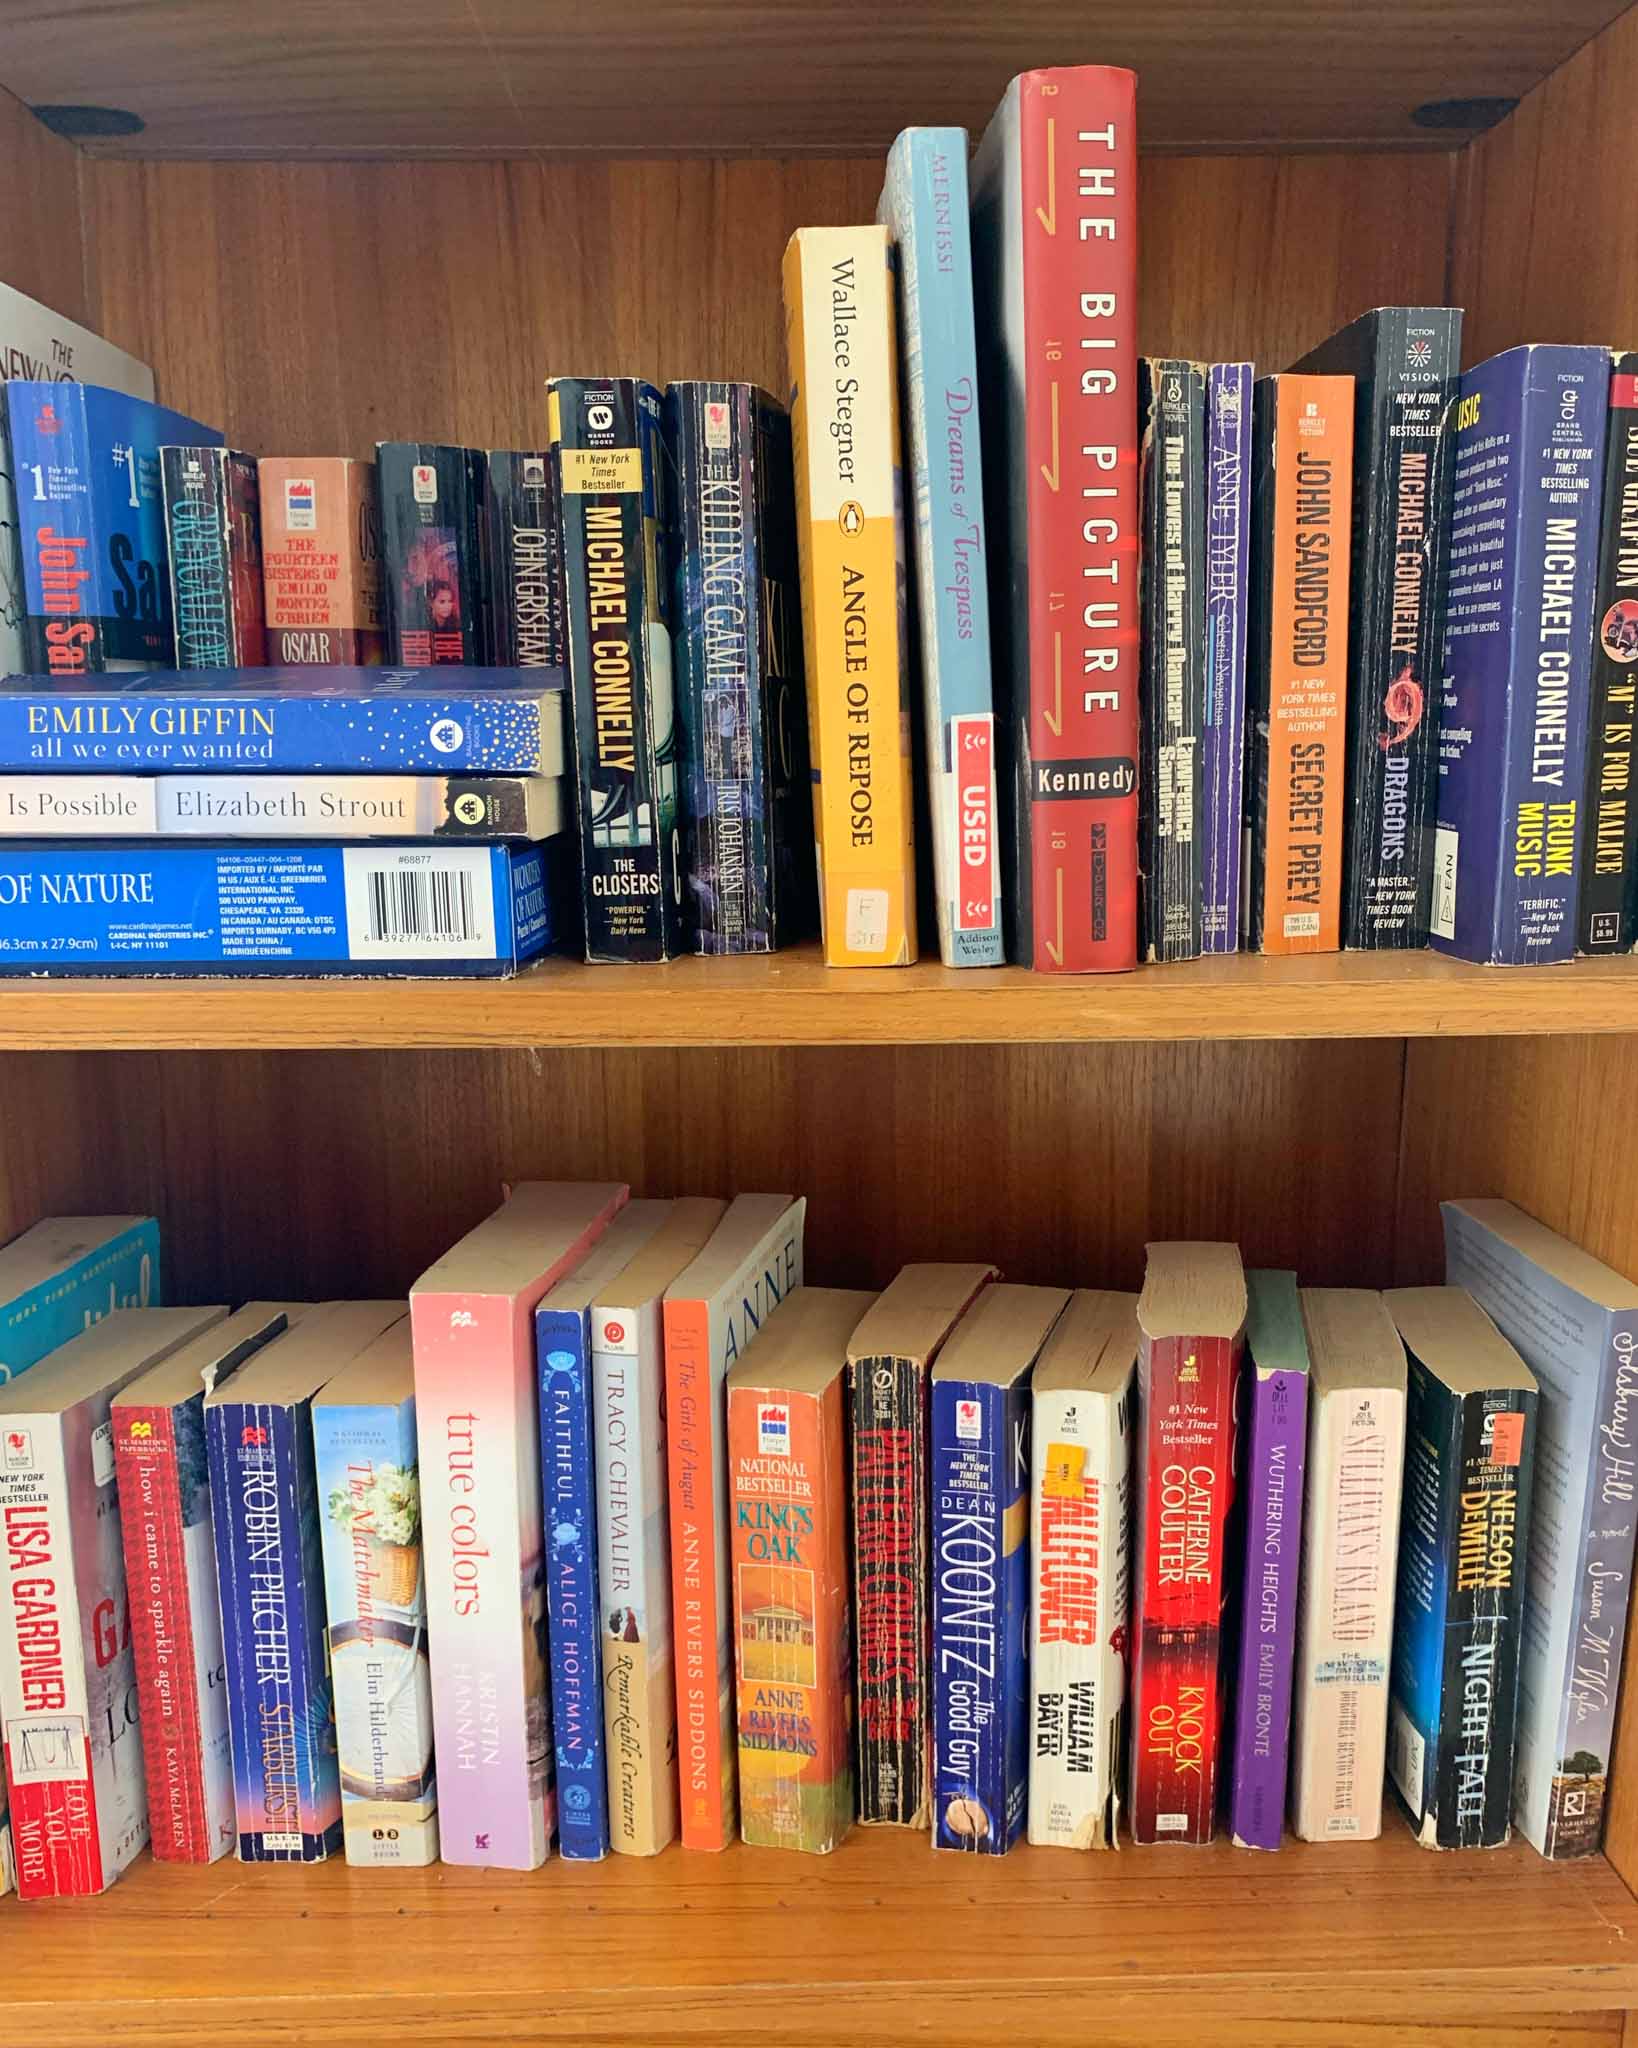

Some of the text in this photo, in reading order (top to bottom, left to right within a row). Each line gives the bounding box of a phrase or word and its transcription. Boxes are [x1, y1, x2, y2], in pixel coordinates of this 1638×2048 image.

[1407, 328, 1435, 337] FICTION
[51, 338, 74, 368] THE
[829, 256, 859, 485] Wallace Stegner
[1399, 372, 1440, 382] VISION
[1557, 374, 1584, 383] FICTION
[584, 393, 614, 402] FICTION
[1395, 393, 1442, 405] NEW YORK
[1078, 121, 1121, 714] THE BIG PICTURE
[1404, 409, 1431, 421] TIMES
[1389, 425, 1442, 437] BESTSELLER
[1553, 448, 1571, 459] NEW
[1572, 448, 1593, 459] YORK
[591, 466, 617, 478] Times
[704, 464, 734, 480] THE
[1555, 463, 1577, 474] TIMES
[581, 479, 626, 490] Bestseller
[1212, 446, 1241, 521] ANNE
[1541, 477, 1590, 489] BESTSELLING
[1549, 492, 1579, 504] AUTHOR
[287, 538, 315, 552] THE
[701, 480, 747, 597] KILLING
[264, 552, 339, 566] FOURTEEN
[1292, 452, 1332, 668] JOHN SANDFORD
[1390, 452, 1427, 655] MICHAEL CONNELLY
[264, 567, 340, 581] SISTERS OF
[1210, 532, 1238, 604] TYLER
[277, 582, 328, 595] EMILIO
[1166, 436, 1186, 728] The Loves of Harry Dancer
[275, 597, 331, 610] MONTEZ
[512, 524, 552, 669] JOHN GRISHAM
[275, 611, 331, 625] O'BRIEN
[281, 631, 331, 664] OSCAR
[585, 506, 636, 773] MICHAEL CONNELLY
[703, 604, 747, 687] GAME
[1532, 517, 1577, 787] MICHAEL CONNELLY
[842, 565, 873, 848] ANGLE OF REPOSE
[1280, 691, 1337, 704] YORK TIMES
[27, 706, 276, 736] EMILY GIFFIN
[1277, 706, 1338, 720] BESTSELLING
[1287, 721, 1326, 733] AUTHOR
[31, 737, 274, 760] all we ever wanted
[1038, 764, 1135, 793] Kennedy
[1288, 742, 1325, 834] SECRET
[8, 789, 407, 819] Is Possible Elizabeth Strout
[1380, 757, 1410, 861] DRAGONS
[962, 785, 988, 867] USED
[1514, 799, 1577, 878] TRUNK MUSIC
[398, 855, 432, 866] #68877
[613, 858, 637, 874] THE
[592, 873, 659, 897] CLOSERS
[1286, 843, 1322, 905] PREY
[0, 871, 154, 905] OF NATURE
[1366, 904, 1413, 915] TIMES BOOK
[610, 926, 647, 936] Daily News
[1373, 918, 1405, 929] REVIEW
[1520, 924, 1560, 934] Times Book
[364, 934, 481, 944] 6 39277 64106 9
[957, 932, 999, 946] Addison
[961, 945, 996, 956] Wesley
[1526, 938, 1553, 947] Review
[1178, 1375, 1200, 1383] NOVEL
[1159, 1418, 1219, 1431] York Times
[1162, 1434, 1214, 1446] Bestseller
[740, 1458, 807, 1477] NATIONAL
[949, 1462, 990, 1473] NEW YORK
[961, 1453, 977, 1462] THE
[606, 1368, 631, 1593] TRACY CHEVALIER
[959, 1471, 981, 1481] TIMES
[1467, 1474, 1515, 1485] BESTSELLER
[1479, 1465, 1504, 1474] TIMES
[9, 1483, 36, 1493] TIMES
[736, 1476, 812, 1497] BESTSELLER
[949, 1480, 990, 1491] BESTSELLER
[0, 1493, 49, 1504] ESTSELLER
[941, 1496, 996, 1513] DEAN
[447, 1412, 490, 1616] true colors
[1157, 1464, 1188, 1586] COULTER
[1185, 1465, 1216, 1586] CATHERINE
[746, 1532, 801, 1564] OAK
[1483, 1489, 1517, 1589] NELSON
[856, 1428, 916, 1684] PATTERN CRIMES
[554, 1389, 583, 1750] FAITHFUL ALICE HOFFMAN
[940, 1512, 997, 1679] KOONTZ
[4, 1504, 66, 1712] LISA GARDNER
[754, 1687, 804, 1711] ANNE
[454, 1663, 477, 1770] HANNAH
[748, 1710, 811, 1734] RIVERS
[1037, 1681, 1095, 1773] WILLIAM BAYER
[366, 1662, 390, 1797] Elin Hilderbrand
[941, 1680, 996, 1779] The Good Guy
[1148, 1704, 1175, 1758] OUT
[1174, 1685, 1206, 1774] KNOCK
[1454, 1643, 1495, 1828] NIGHT FALL
[742, 1732, 817, 1757] SIDDONS
[63, 1783, 91, 1842] LOVE
[43, 1806, 67, 1850] YOU
[18, 1818, 46, 1883] MORE
